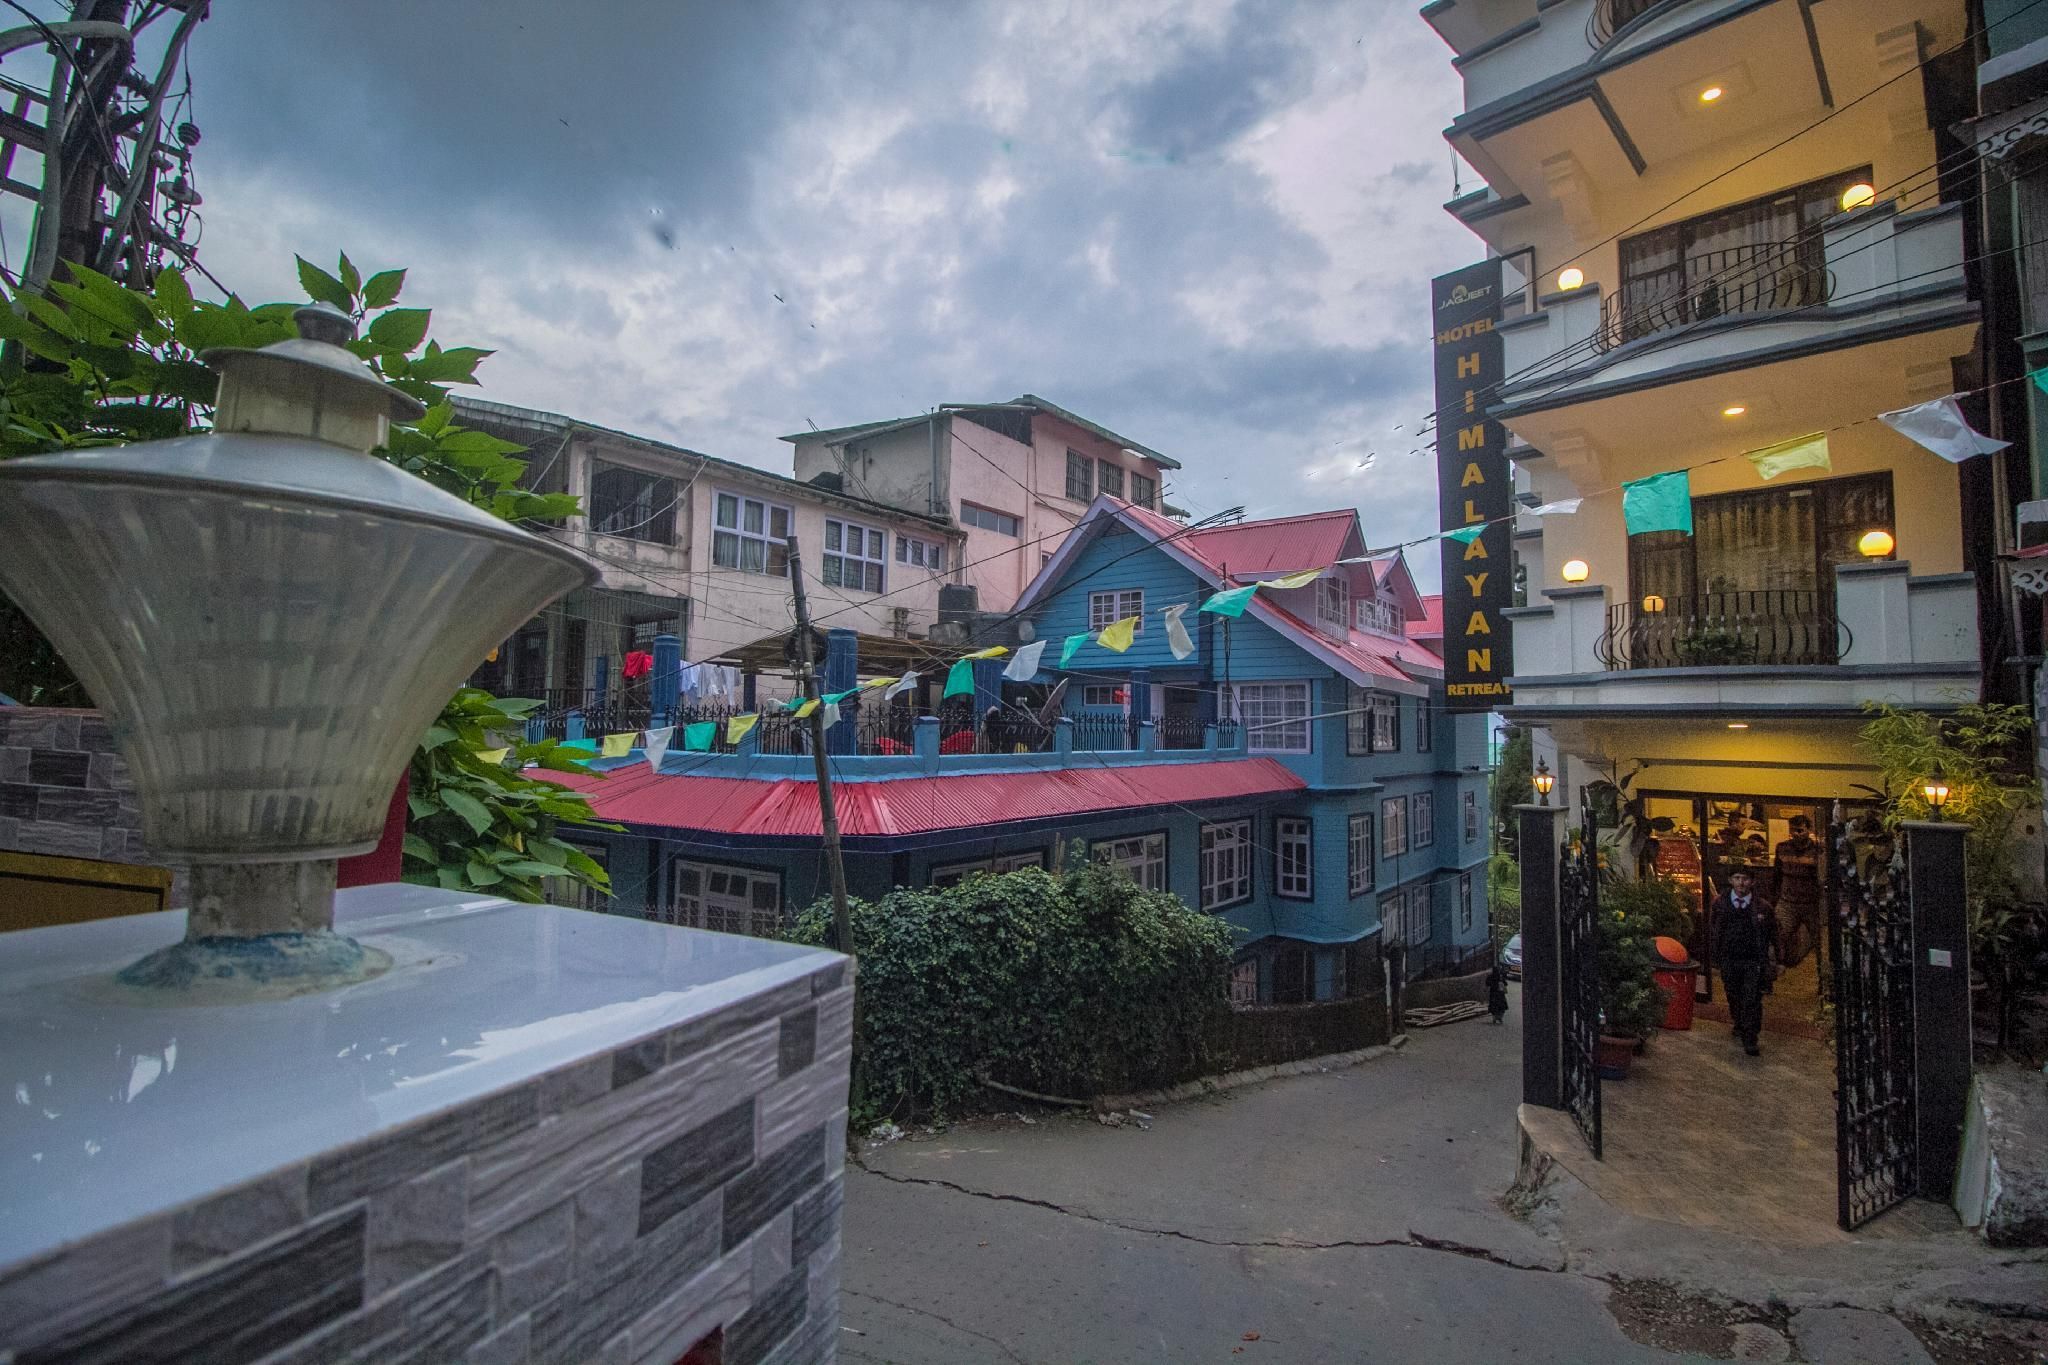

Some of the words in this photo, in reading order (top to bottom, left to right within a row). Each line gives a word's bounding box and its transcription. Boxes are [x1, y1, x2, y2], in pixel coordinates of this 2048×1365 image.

[1438, 285, 1492, 310] JAGJEET
[1437, 317, 1496, 344] HOTEL
[1457, 351, 1491, 673] HIMALAYAN
